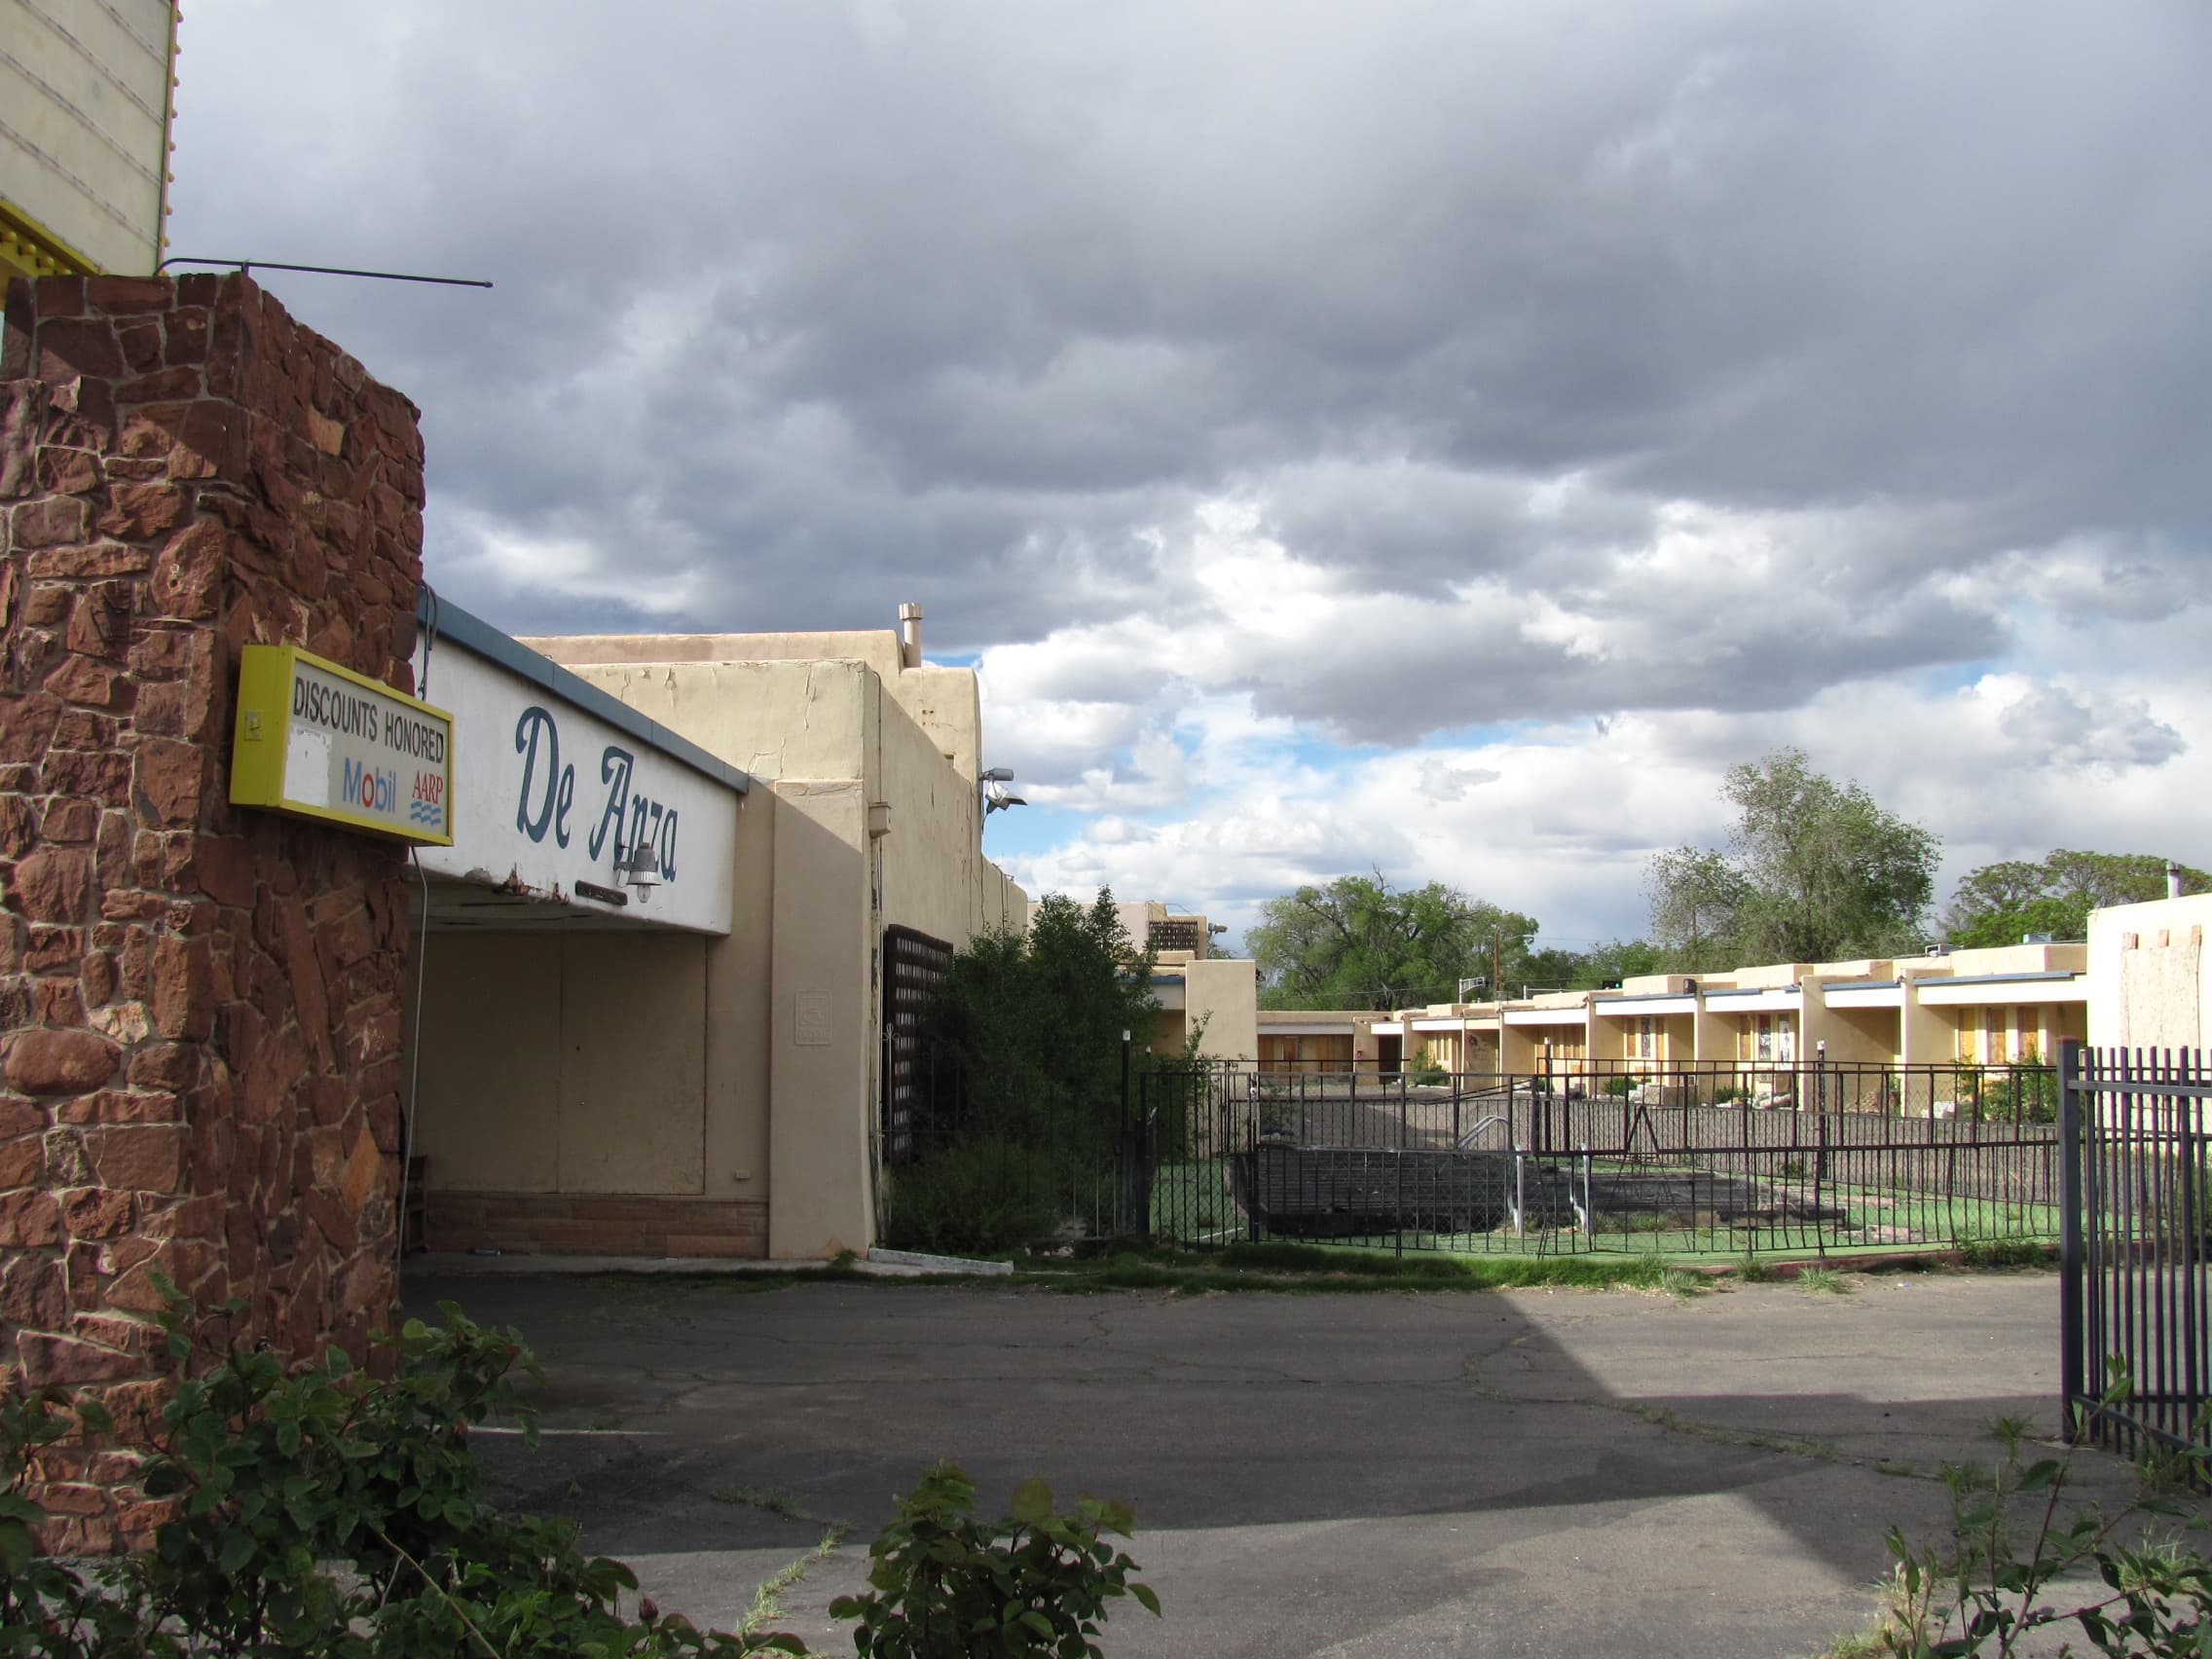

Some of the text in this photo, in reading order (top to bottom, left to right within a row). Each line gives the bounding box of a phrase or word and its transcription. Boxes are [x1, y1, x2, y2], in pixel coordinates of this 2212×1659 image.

[293, 677, 444, 763] DISCOUNTS HONORED
[343, 756, 396, 814] Mobil
[412, 770, 444, 805] AARP
[515, 706, 679, 882] De Anza
